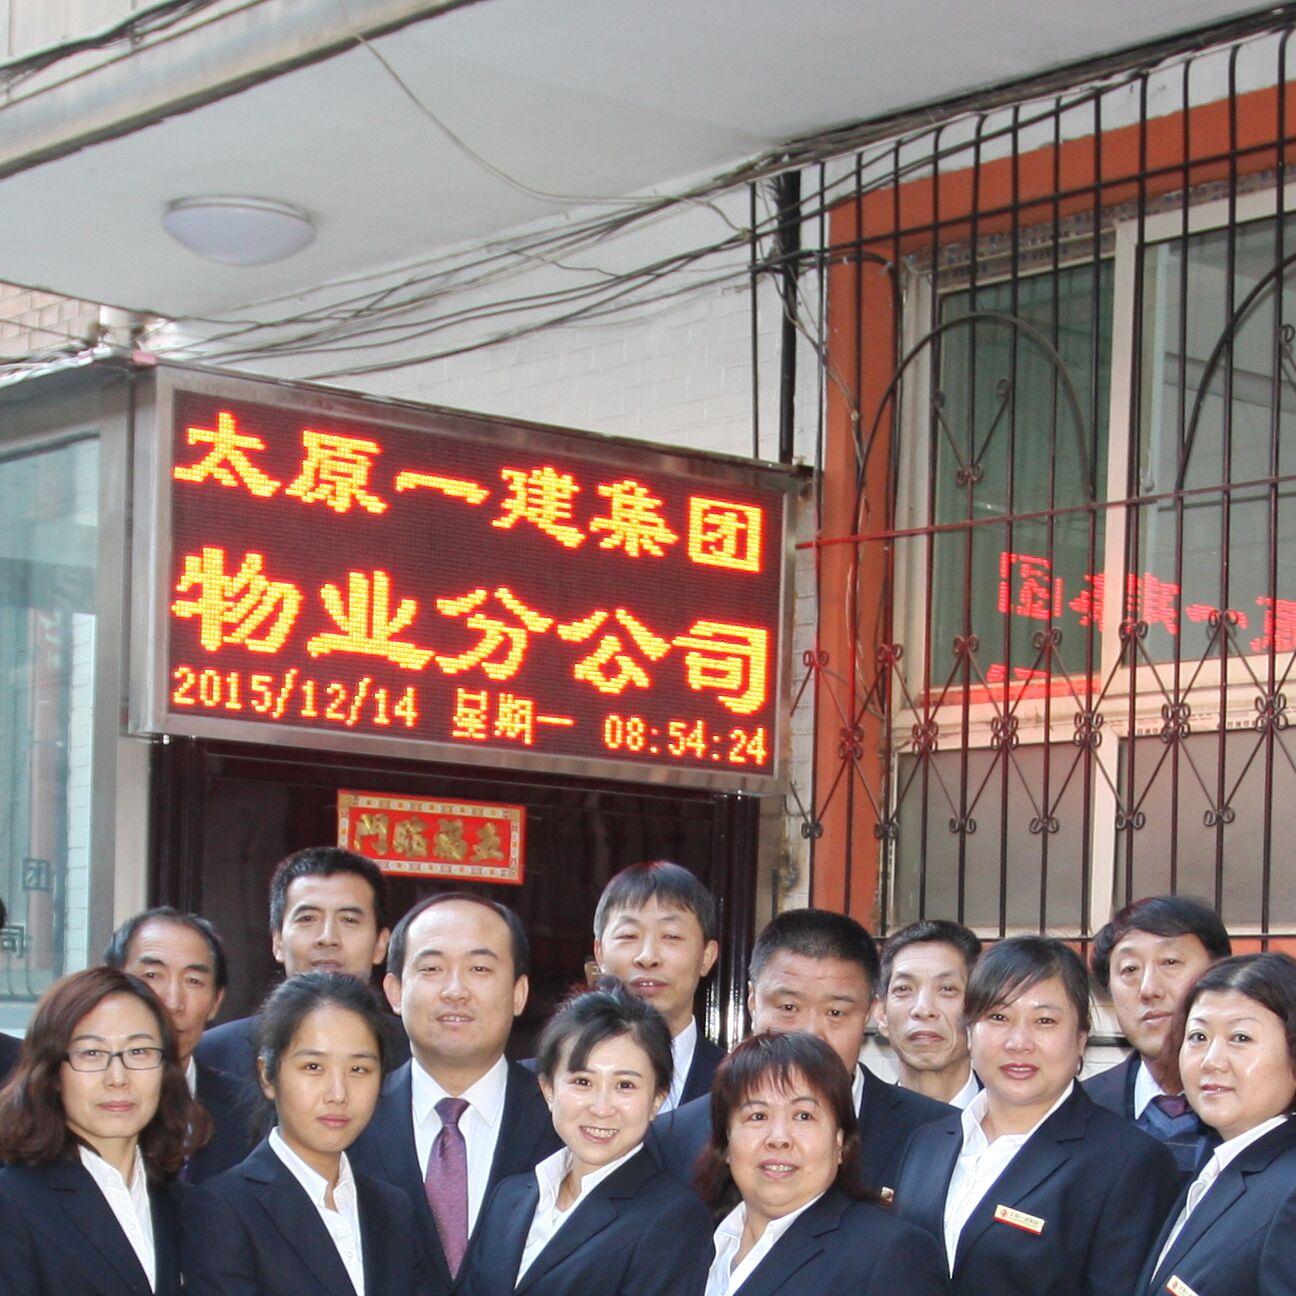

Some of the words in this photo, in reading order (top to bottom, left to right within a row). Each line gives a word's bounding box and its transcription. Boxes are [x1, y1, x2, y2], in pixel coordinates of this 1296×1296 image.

[173, 411, 763, 573] 太原一建集团
[171, 546, 769, 715] 物业分公司
[173, 667, 418, 727] 2015/12/14
[452, 688, 575, 745] 星期一
[604, 714, 767, 765] 08:54:24
